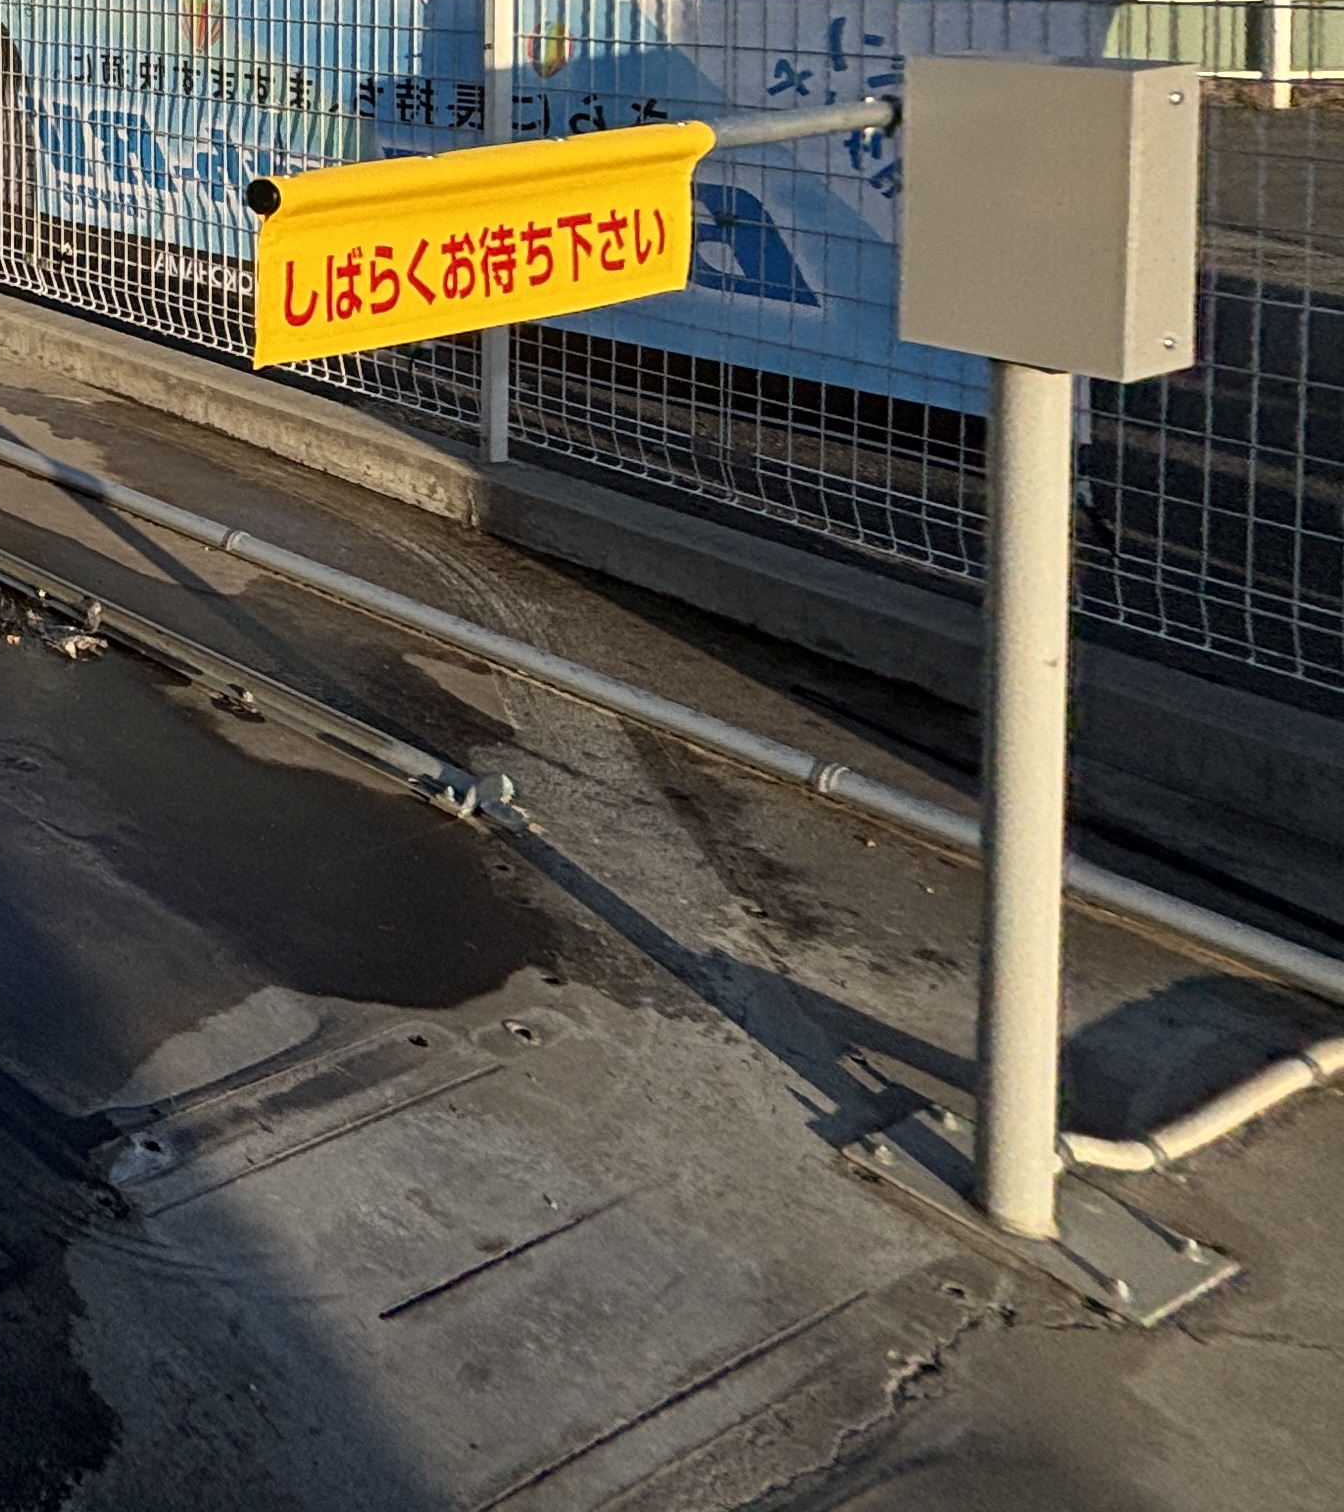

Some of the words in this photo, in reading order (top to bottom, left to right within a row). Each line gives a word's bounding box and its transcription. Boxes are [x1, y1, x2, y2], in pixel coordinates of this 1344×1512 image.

[283, 208, 666, 328] しばらくお待ち下さい
